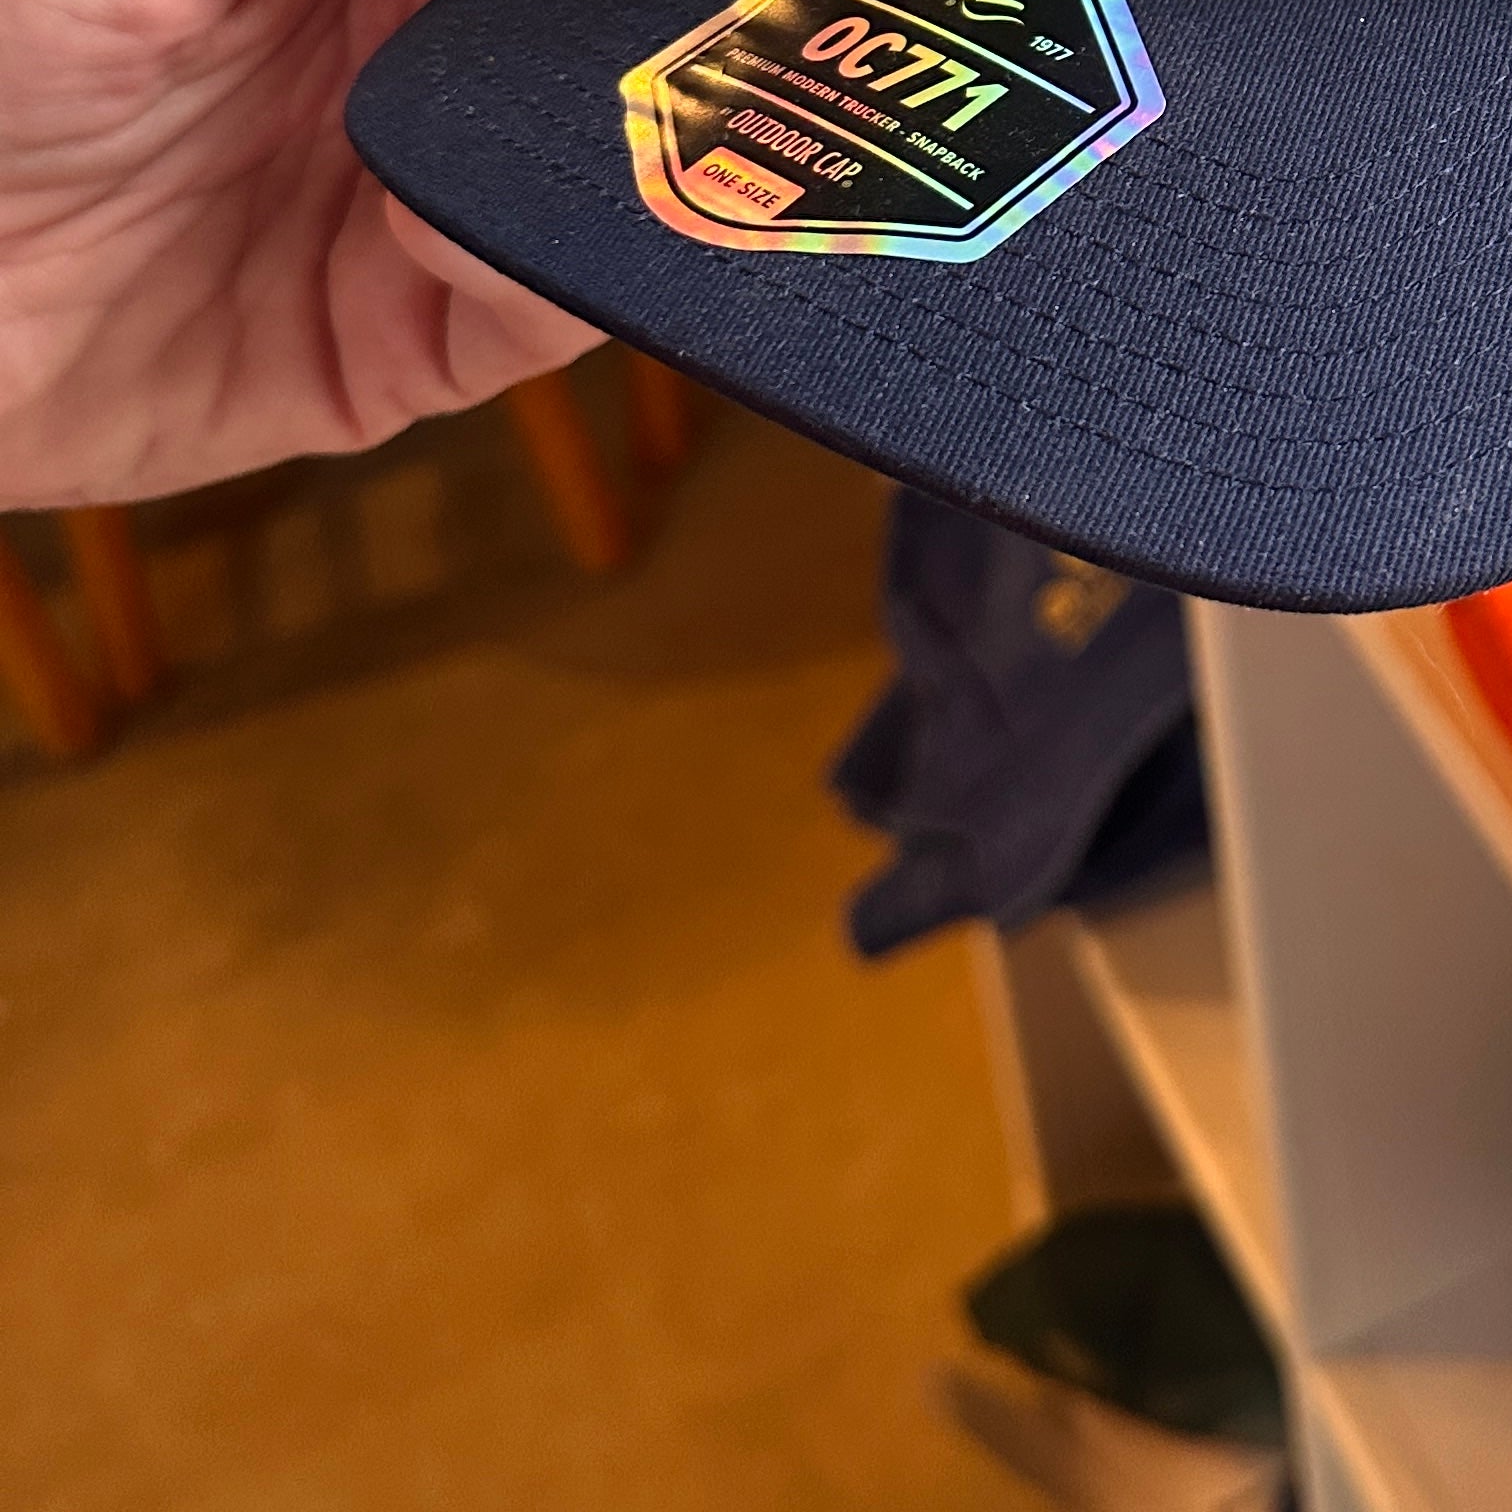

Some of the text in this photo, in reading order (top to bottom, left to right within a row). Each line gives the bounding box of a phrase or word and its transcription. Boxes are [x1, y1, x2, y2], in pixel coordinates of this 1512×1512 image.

[801, 17, 1009, 132] OC771
[1029, 35, 1074, 61] 1977
[726, 47, 788, 76] PREMIUM
[783, 70, 838, 102] MODERN
[837, 96, 902, 133] TRUCKER
[906, 132, 985, 181] SNAPBACK
[727, 109, 824, 165] OUTDOOR
[703, 163, 781, 209] ONE SIZE
